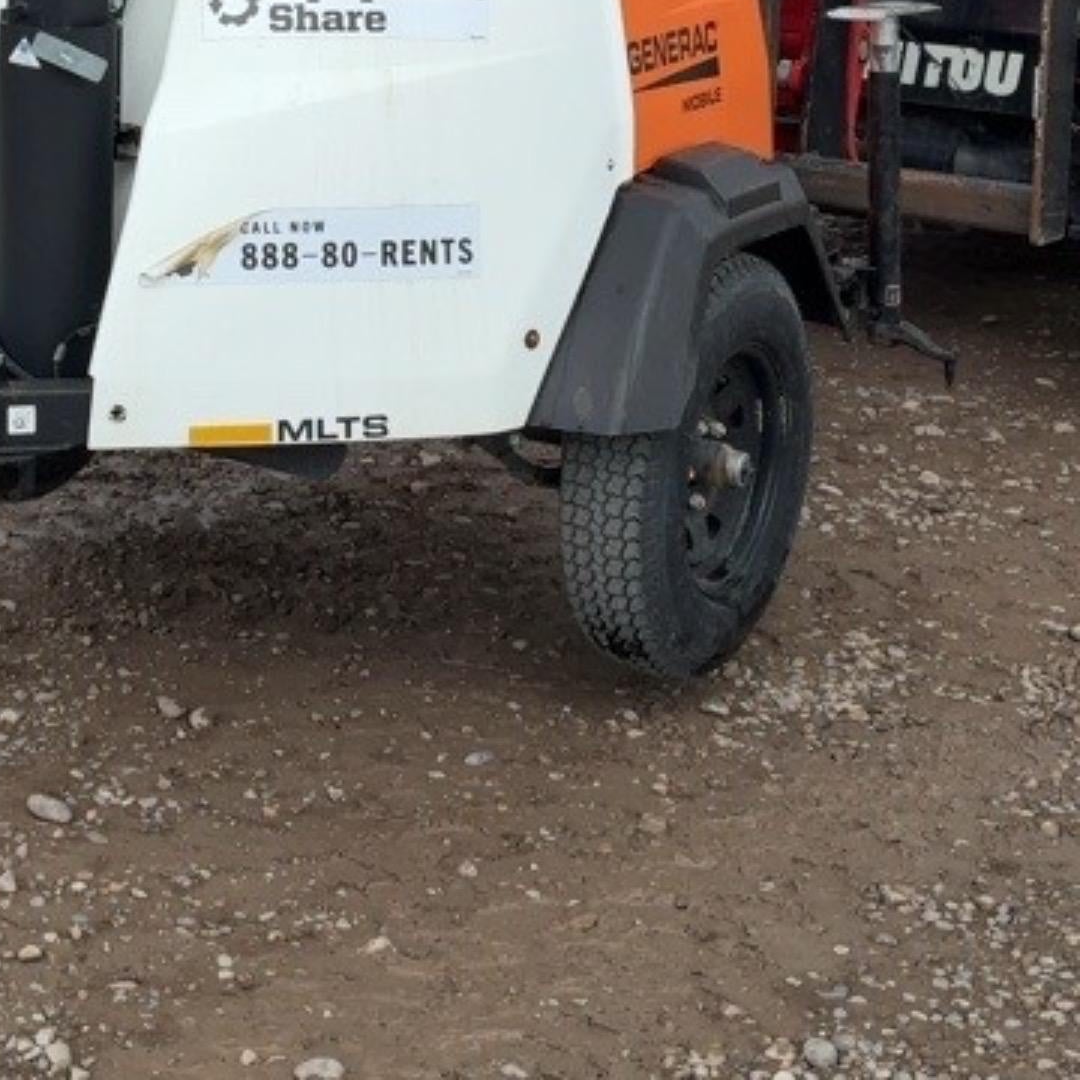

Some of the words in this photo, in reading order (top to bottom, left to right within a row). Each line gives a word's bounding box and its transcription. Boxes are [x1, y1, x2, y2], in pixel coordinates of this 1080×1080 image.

[269, 3, 387, 33] Share
[627, 20, 718, 76] GENERAC
[239, 221, 281, 235] CALL
[290, 220, 325, 233] NOW
[240, 237, 474, 271] 888-80-RENTS
[277, 414, 389, 442] MLTS
